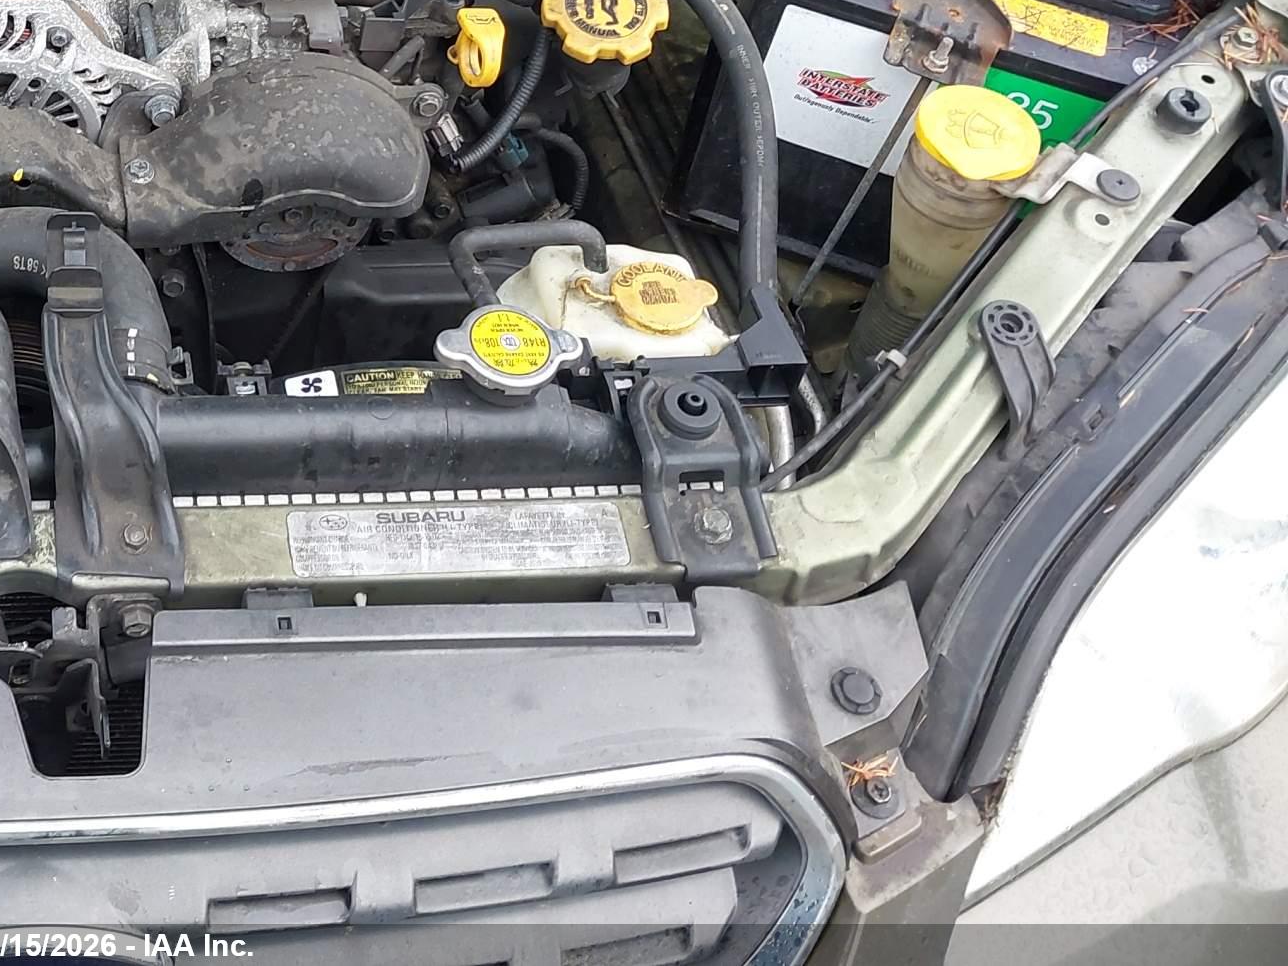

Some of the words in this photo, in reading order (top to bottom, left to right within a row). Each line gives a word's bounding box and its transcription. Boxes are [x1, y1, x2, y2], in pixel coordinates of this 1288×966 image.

[797, 78, 877, 108] BATTERIES
[799, 68, 889, 102] INTERSTATE
[616, 262, 688, 287] COOLANT
[346, 372, 395, 383] CAUTION
[376, 510, 466, 524] SUBARU
